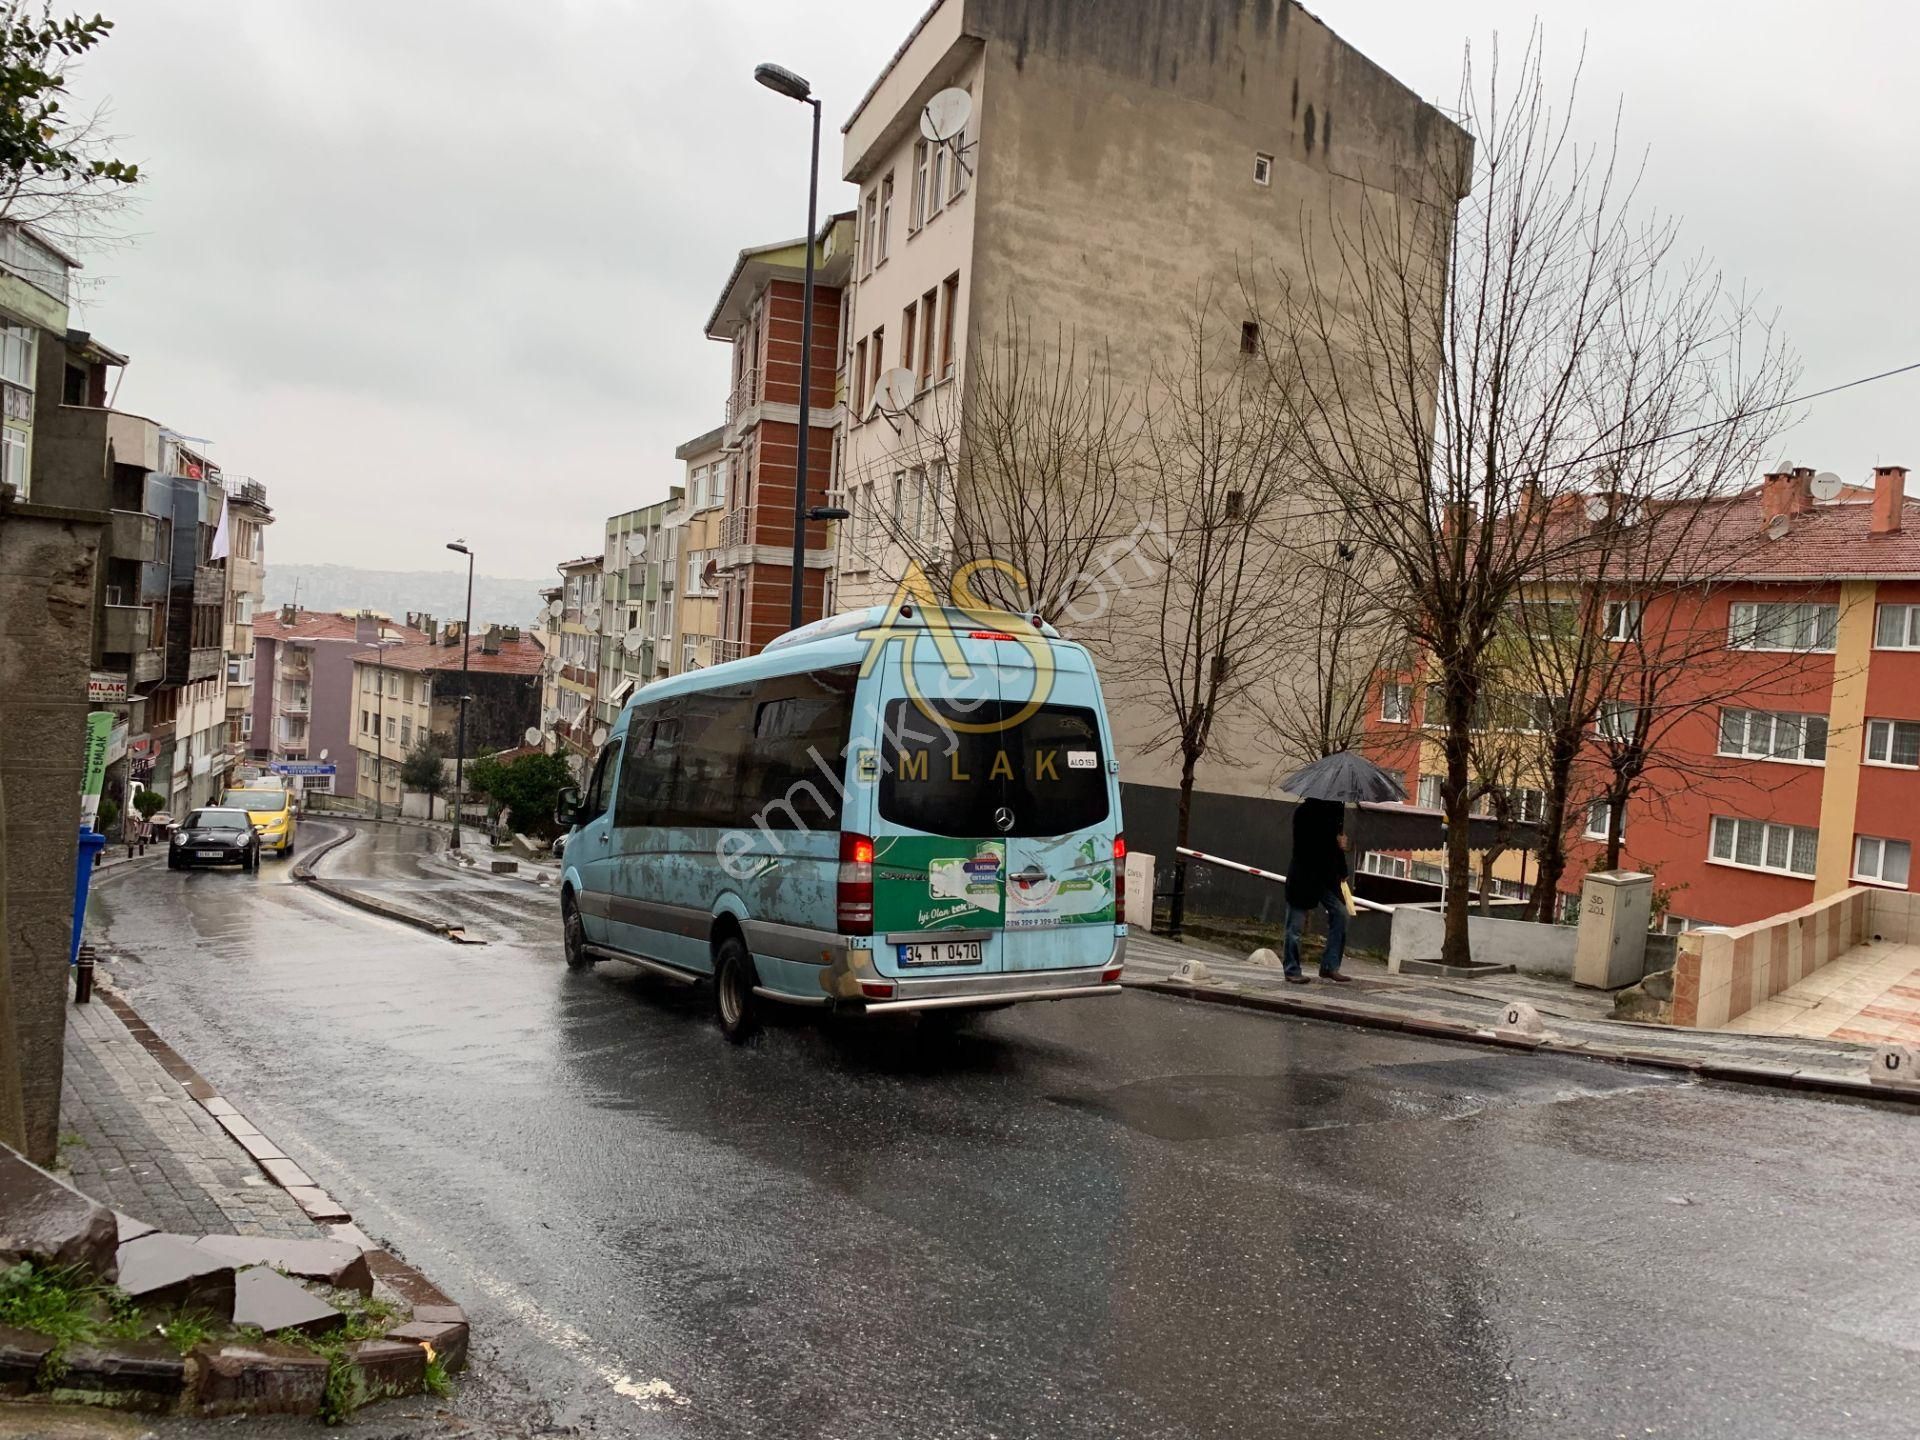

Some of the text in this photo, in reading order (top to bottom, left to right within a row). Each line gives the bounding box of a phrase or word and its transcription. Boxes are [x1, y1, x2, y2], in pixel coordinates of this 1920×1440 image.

[93, 736, 107, 765] EMLAK
[906, 946, 922, 961] 34
[947, 943, 978, 959] 0470
